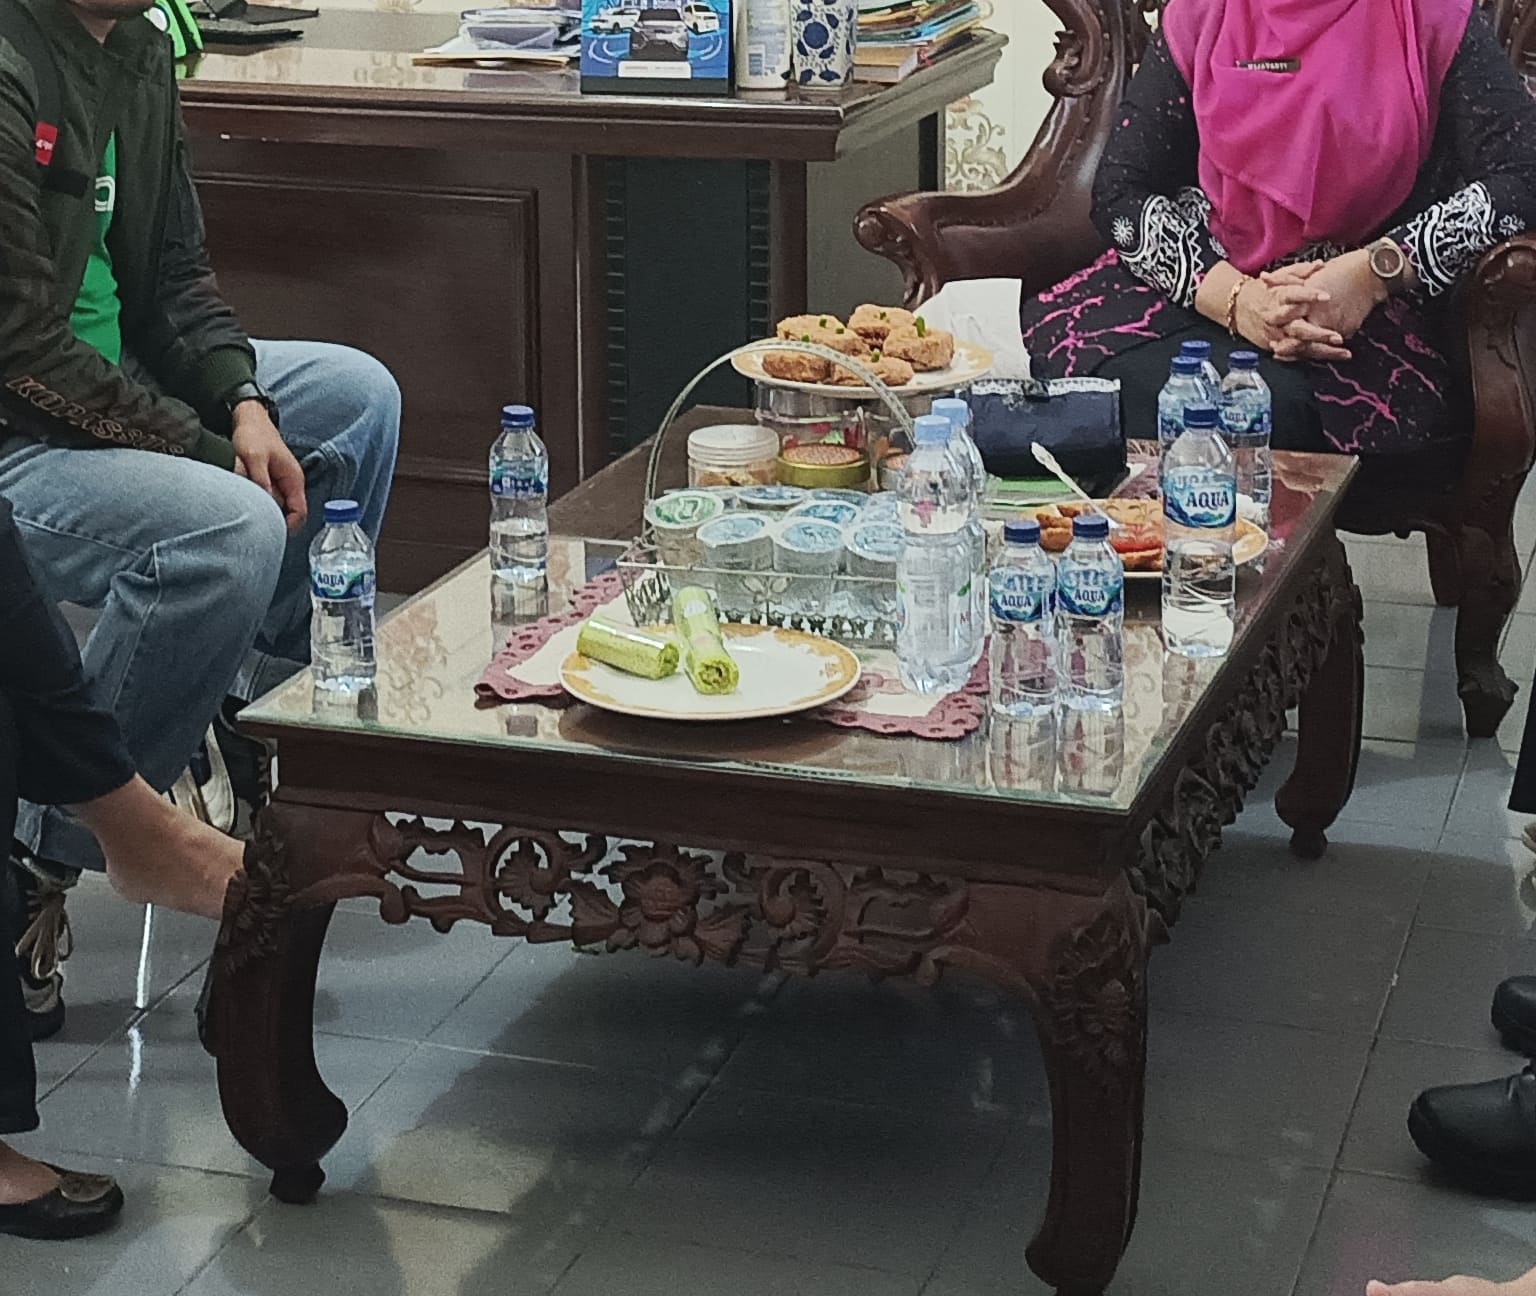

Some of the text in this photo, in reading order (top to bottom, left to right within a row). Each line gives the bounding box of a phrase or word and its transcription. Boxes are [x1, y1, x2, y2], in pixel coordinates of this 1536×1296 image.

[1186, 490, 1230, 511] AQUA
[317, 572, 345, 587] AQUA
[1000, 594, 1033, 608] AQUA
[1074, 588, 1106, 603] AQUA
